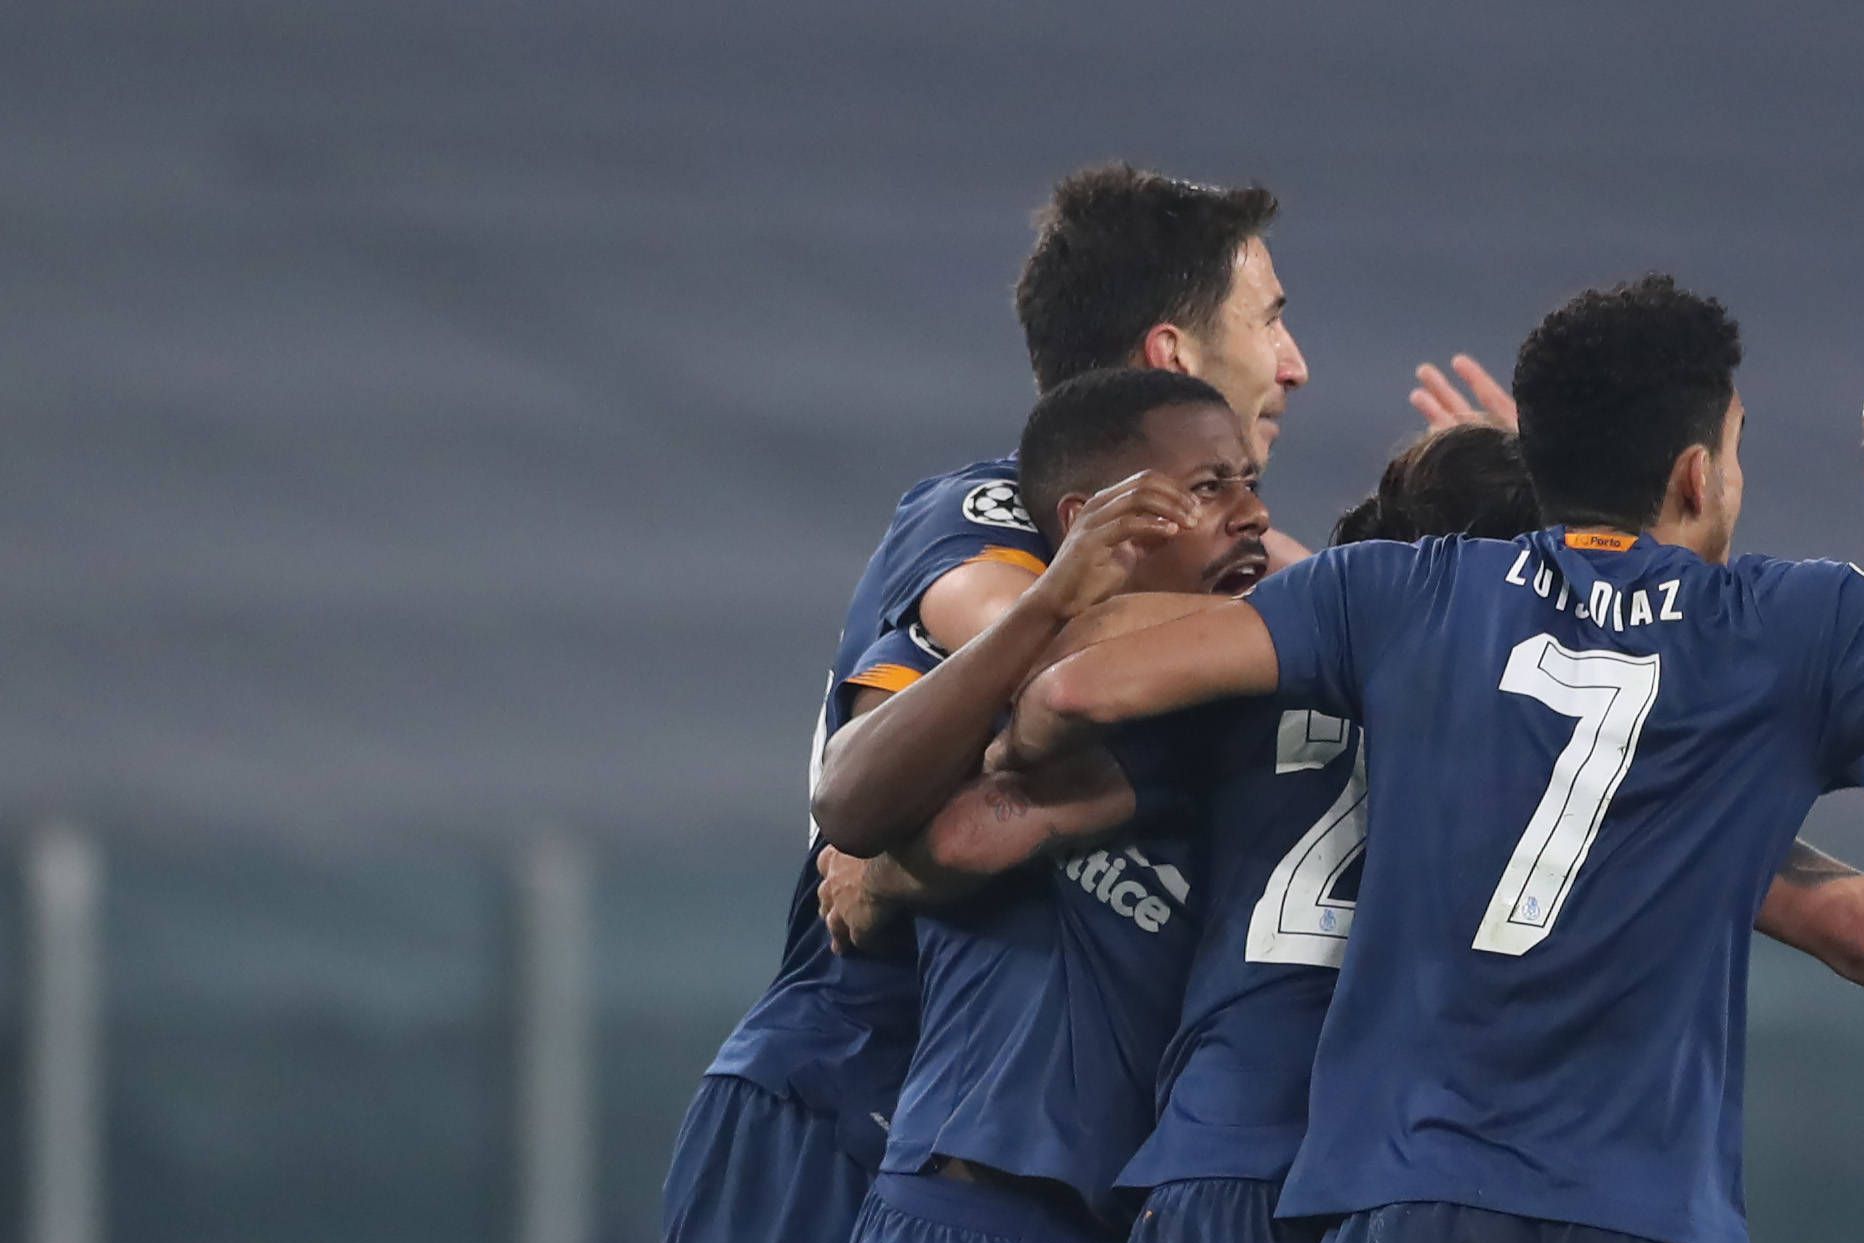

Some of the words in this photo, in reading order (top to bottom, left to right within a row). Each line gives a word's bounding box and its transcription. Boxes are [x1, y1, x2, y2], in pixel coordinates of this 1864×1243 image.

[1590, 535, 1622, 548] Porto
[1589, 578, 1684, 632] DIAZ
[1471, 632, 1661, 957] 7
